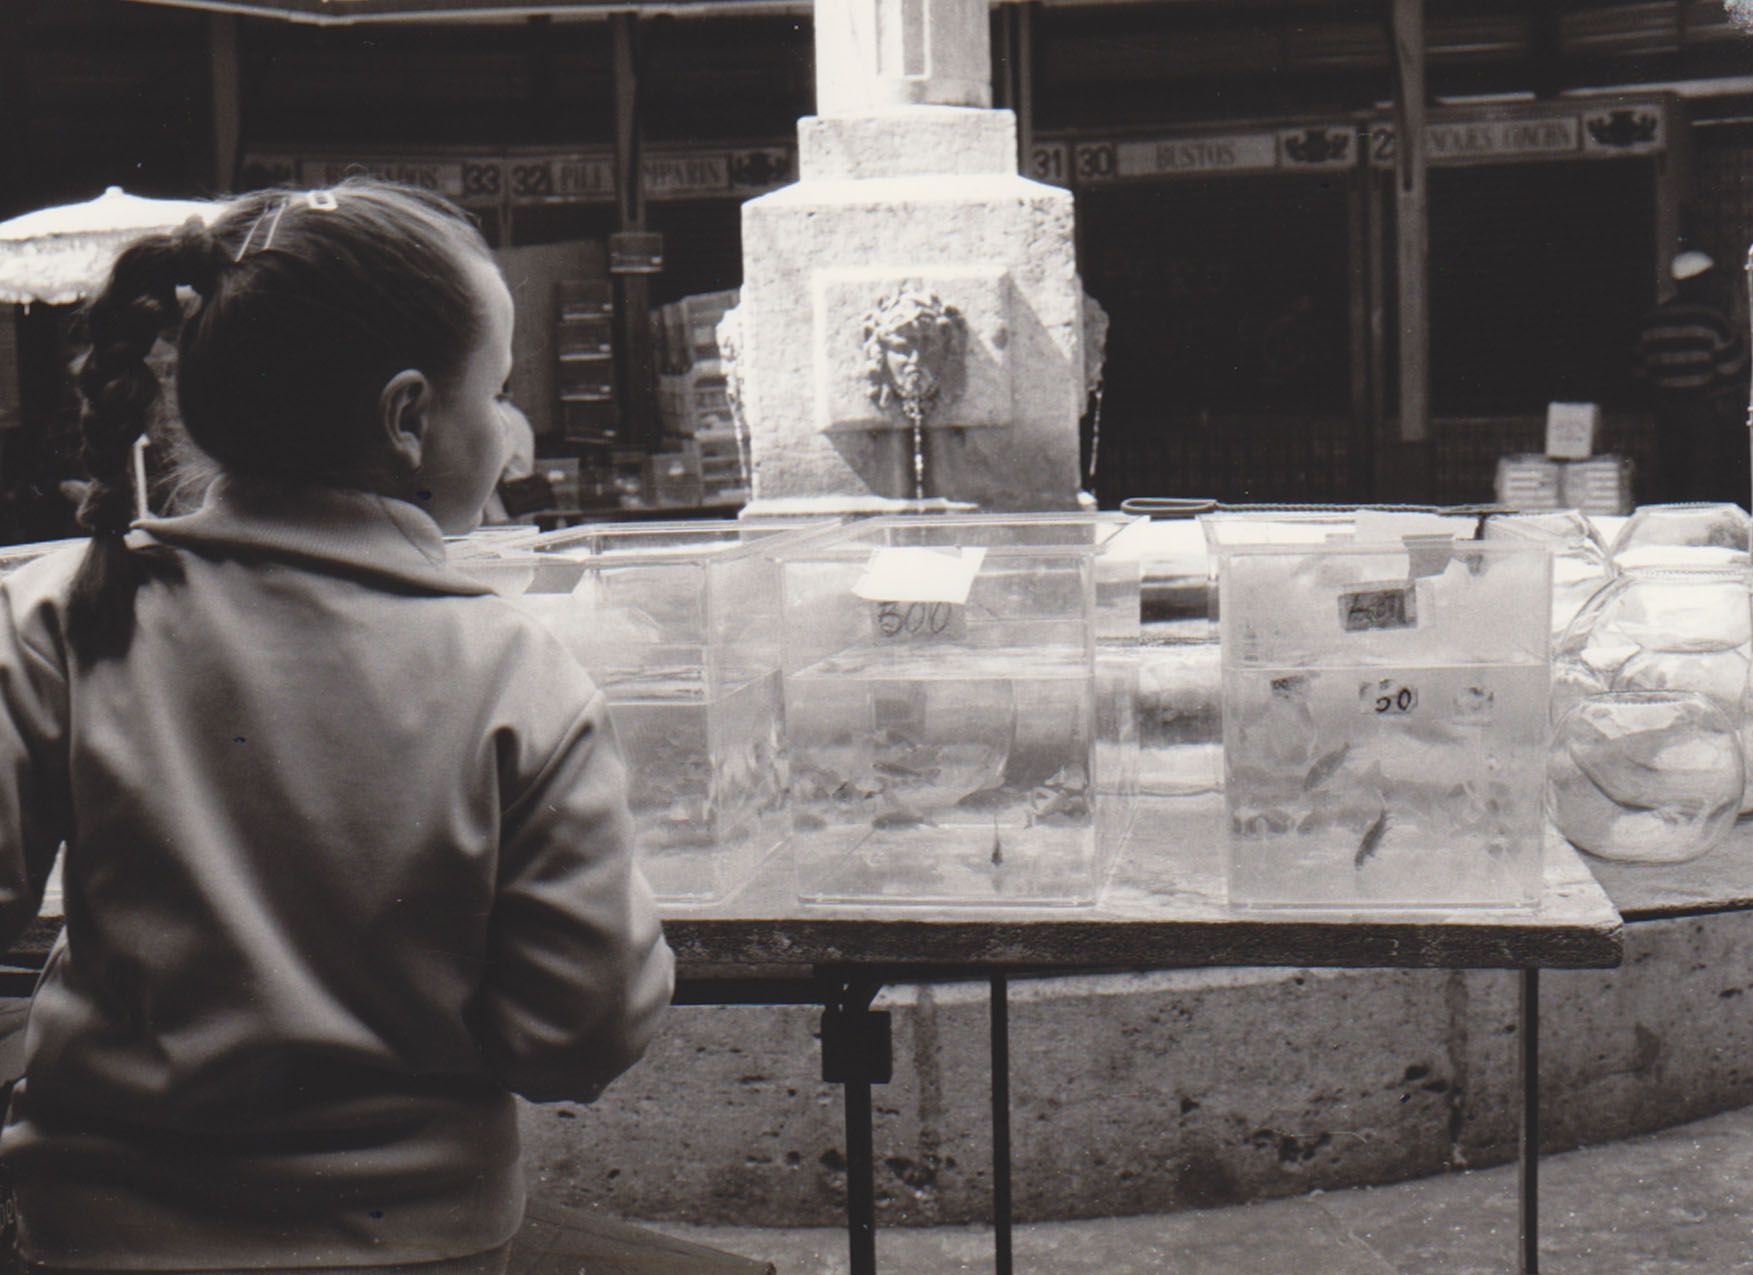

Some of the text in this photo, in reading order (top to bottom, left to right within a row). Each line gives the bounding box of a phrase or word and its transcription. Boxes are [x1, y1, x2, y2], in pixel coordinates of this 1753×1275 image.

[1032, 149, 1062, 178] 31
[1079, 147, 1114, 176] 30
[1156, 143, 1236, 169] BUSTOS
[463, 165, 499, 195] 33
[512, 164, 547, 195] 32
[878, 600, 952, 637] 500
